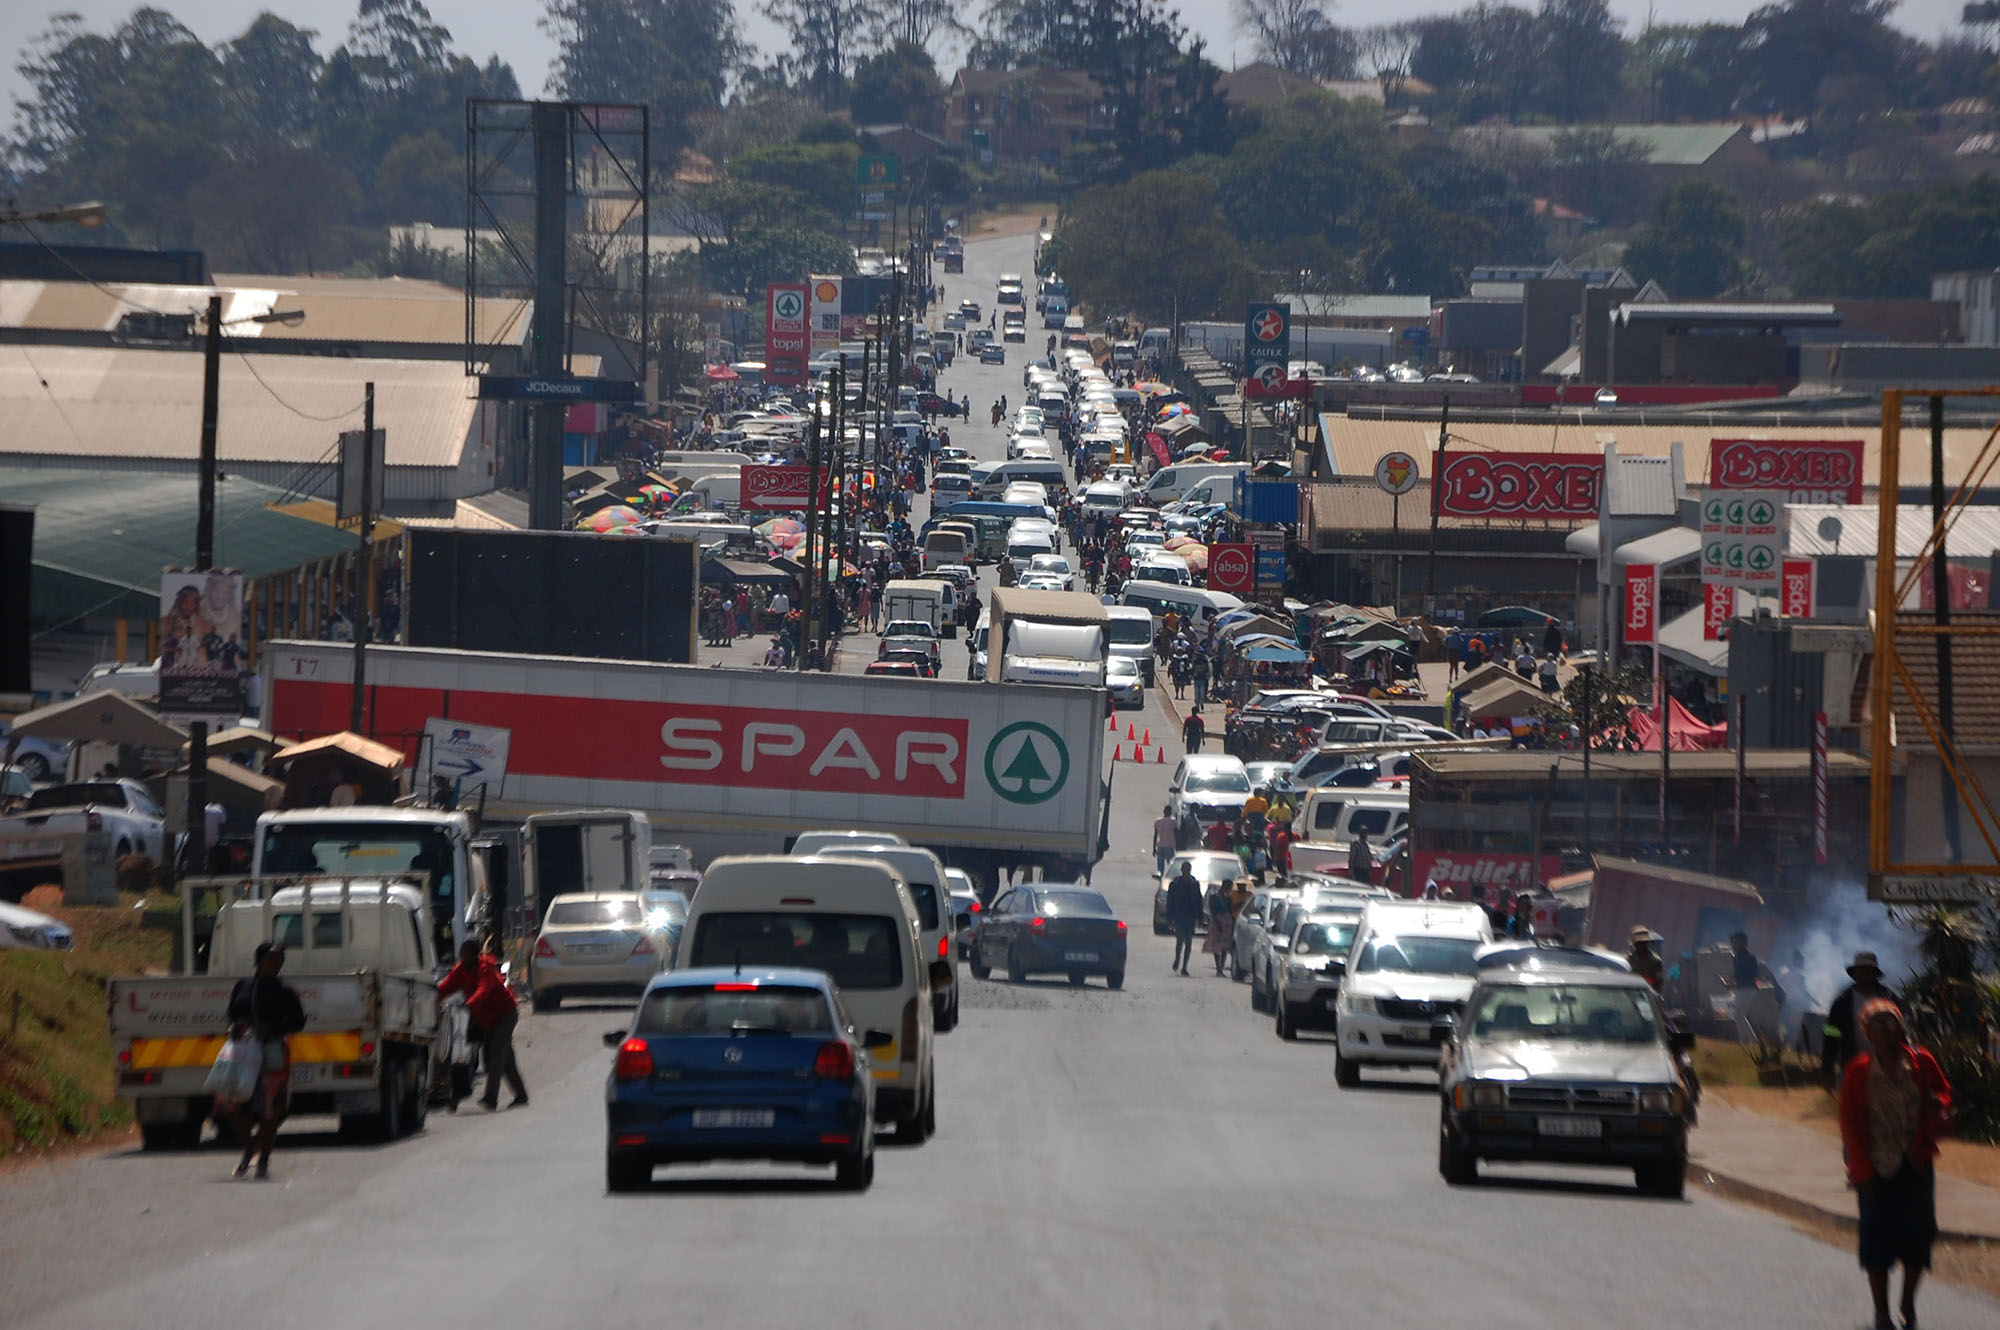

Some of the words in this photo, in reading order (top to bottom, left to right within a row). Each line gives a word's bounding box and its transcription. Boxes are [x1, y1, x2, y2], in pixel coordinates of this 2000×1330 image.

[772, 338, 803, 351] tops!
[1250, 347, 1282, 357] CALTEX
[526, 381, 582, 394] JCDecaux
[1720, 442, 1855, 488] BOXER
[1444, 454, 1602, 513] BOXE
[1218, 560, 1244, 573] absa
[1628, 576, 1650, 631] tops!
[1785, 575, 1808, 617] ops!
[660, 717, 959, 784] SPAR
[1428, 858, 1517, 884] Build
